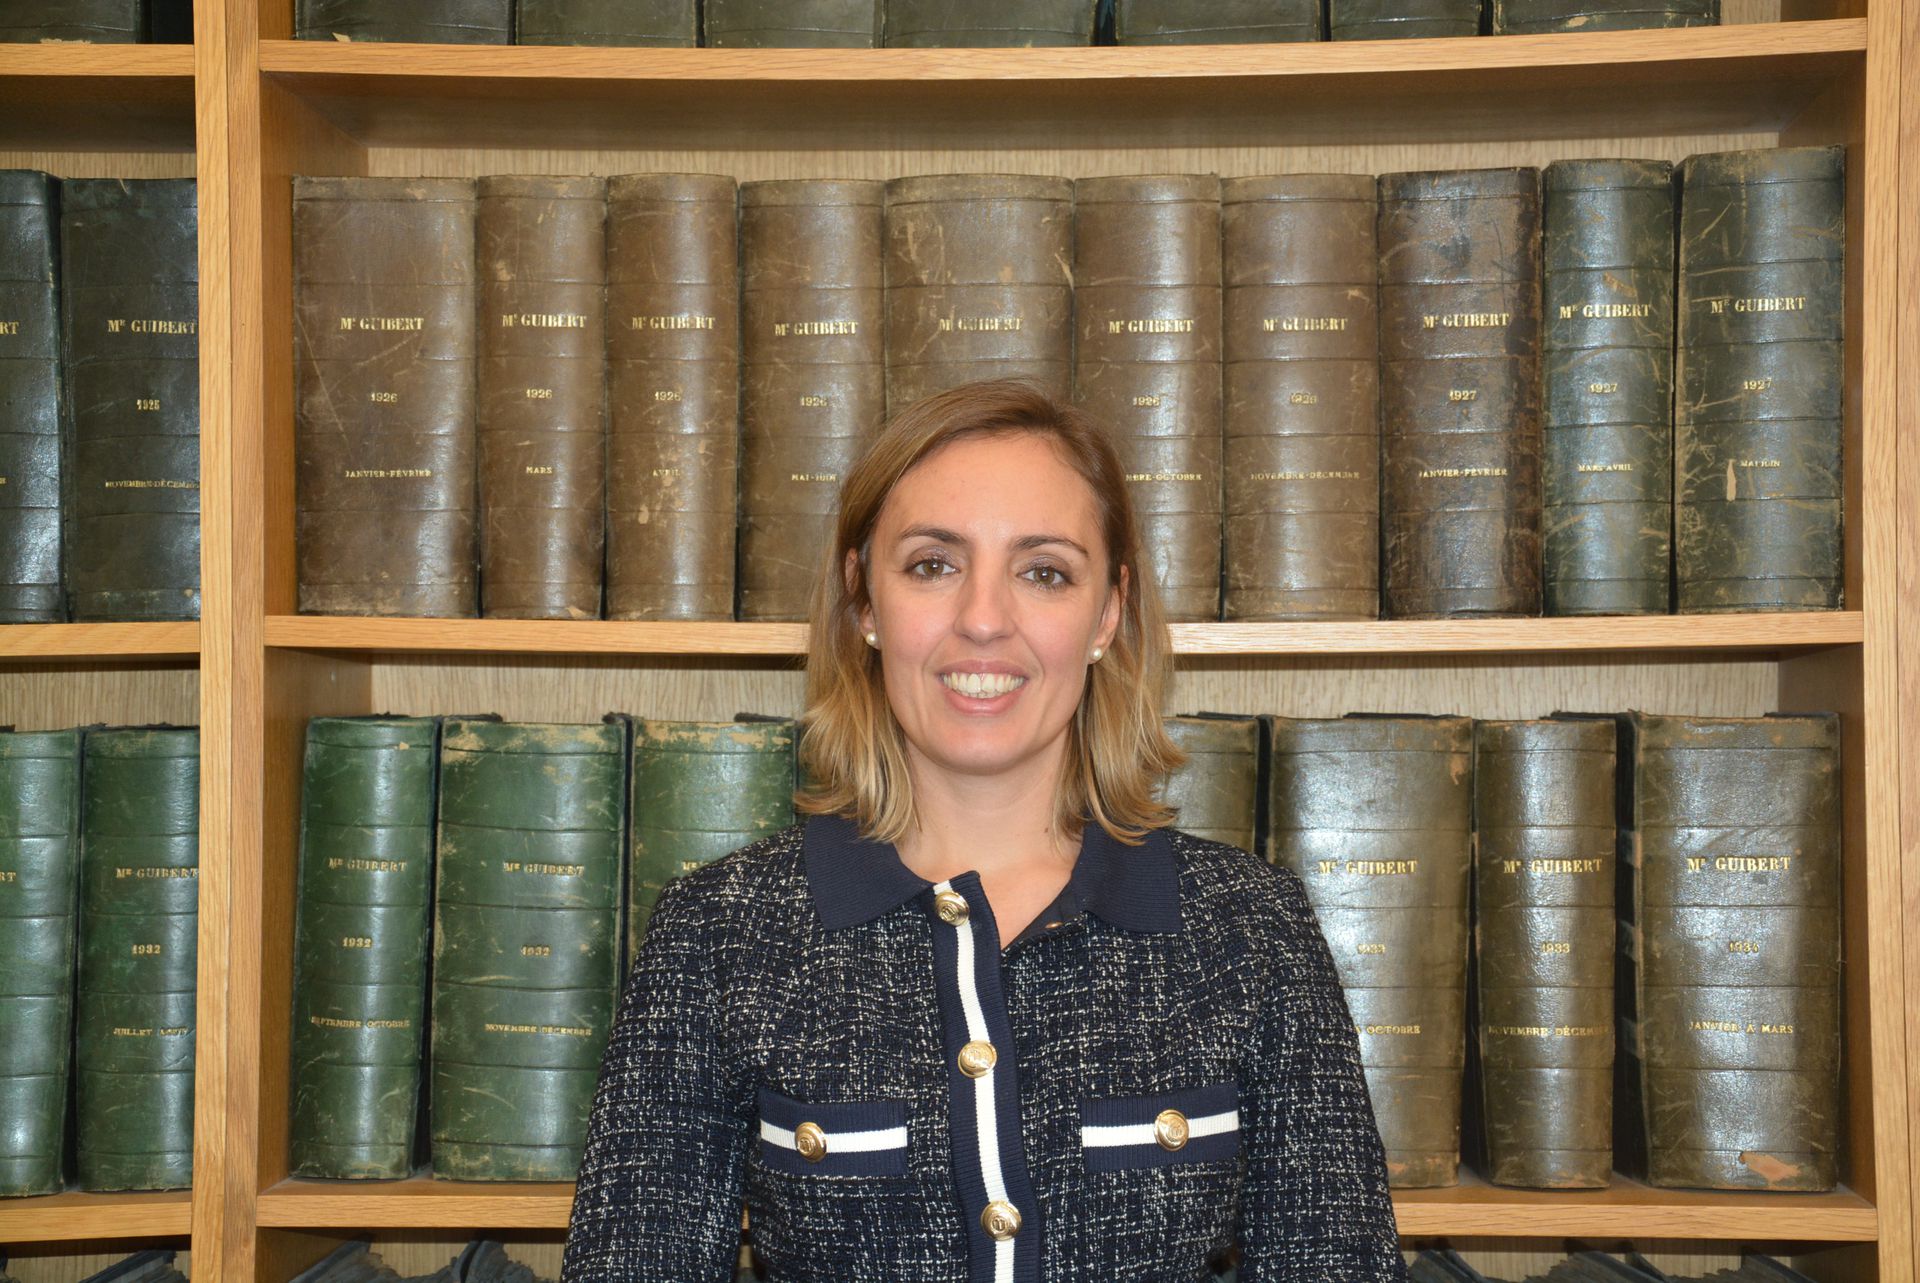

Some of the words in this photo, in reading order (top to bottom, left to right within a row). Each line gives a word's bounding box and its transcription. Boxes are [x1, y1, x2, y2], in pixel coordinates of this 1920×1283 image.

[1582, 303, 1650, 318] GUIBERT
[1734, 297, 1806, 312] GUIBERT
[131, 319, 196, 334] GUIBERT
[359, 317, 425, 331] GUIBERT
[521, 314, 587, 328] GUIBERT
[650, 316, 716, 330] GUIBERT
[1127, 318, 1194, 334] GUIBERT
[1282, 317, 1348, 331] GUIBERT
[1442, 313, 1510, 327] GUIBERT
[793, 320, 859, 336] GUIBERT
[1590, 382, 1618, 393] 1927
[1743, 377, 1772, 390] 1927
[371, 391, 398, 403] 1926
[526, 388, 553, 399] 1926
[654, 391, 682, 402] 1926
[1449, 389, 1477, 401] 1927
[526, 466, 553, 474] MARS
[1345, 860, 1418, 875] GUIBERT
[1531, 858, 1602, 873] GUIBERT
[1715, 856, 1791, 871] GUIBERT
[132, 944, 161, 955] 1932
[343, 937, 372, 948] 1932
[1540, 943, 1570, 954] 1933
[1366, 1025, 1421, 1035] OCTOBRE
[1746, 1023, 1756, 1034] A
[1761, 1024, 1794, 1035] MARS
